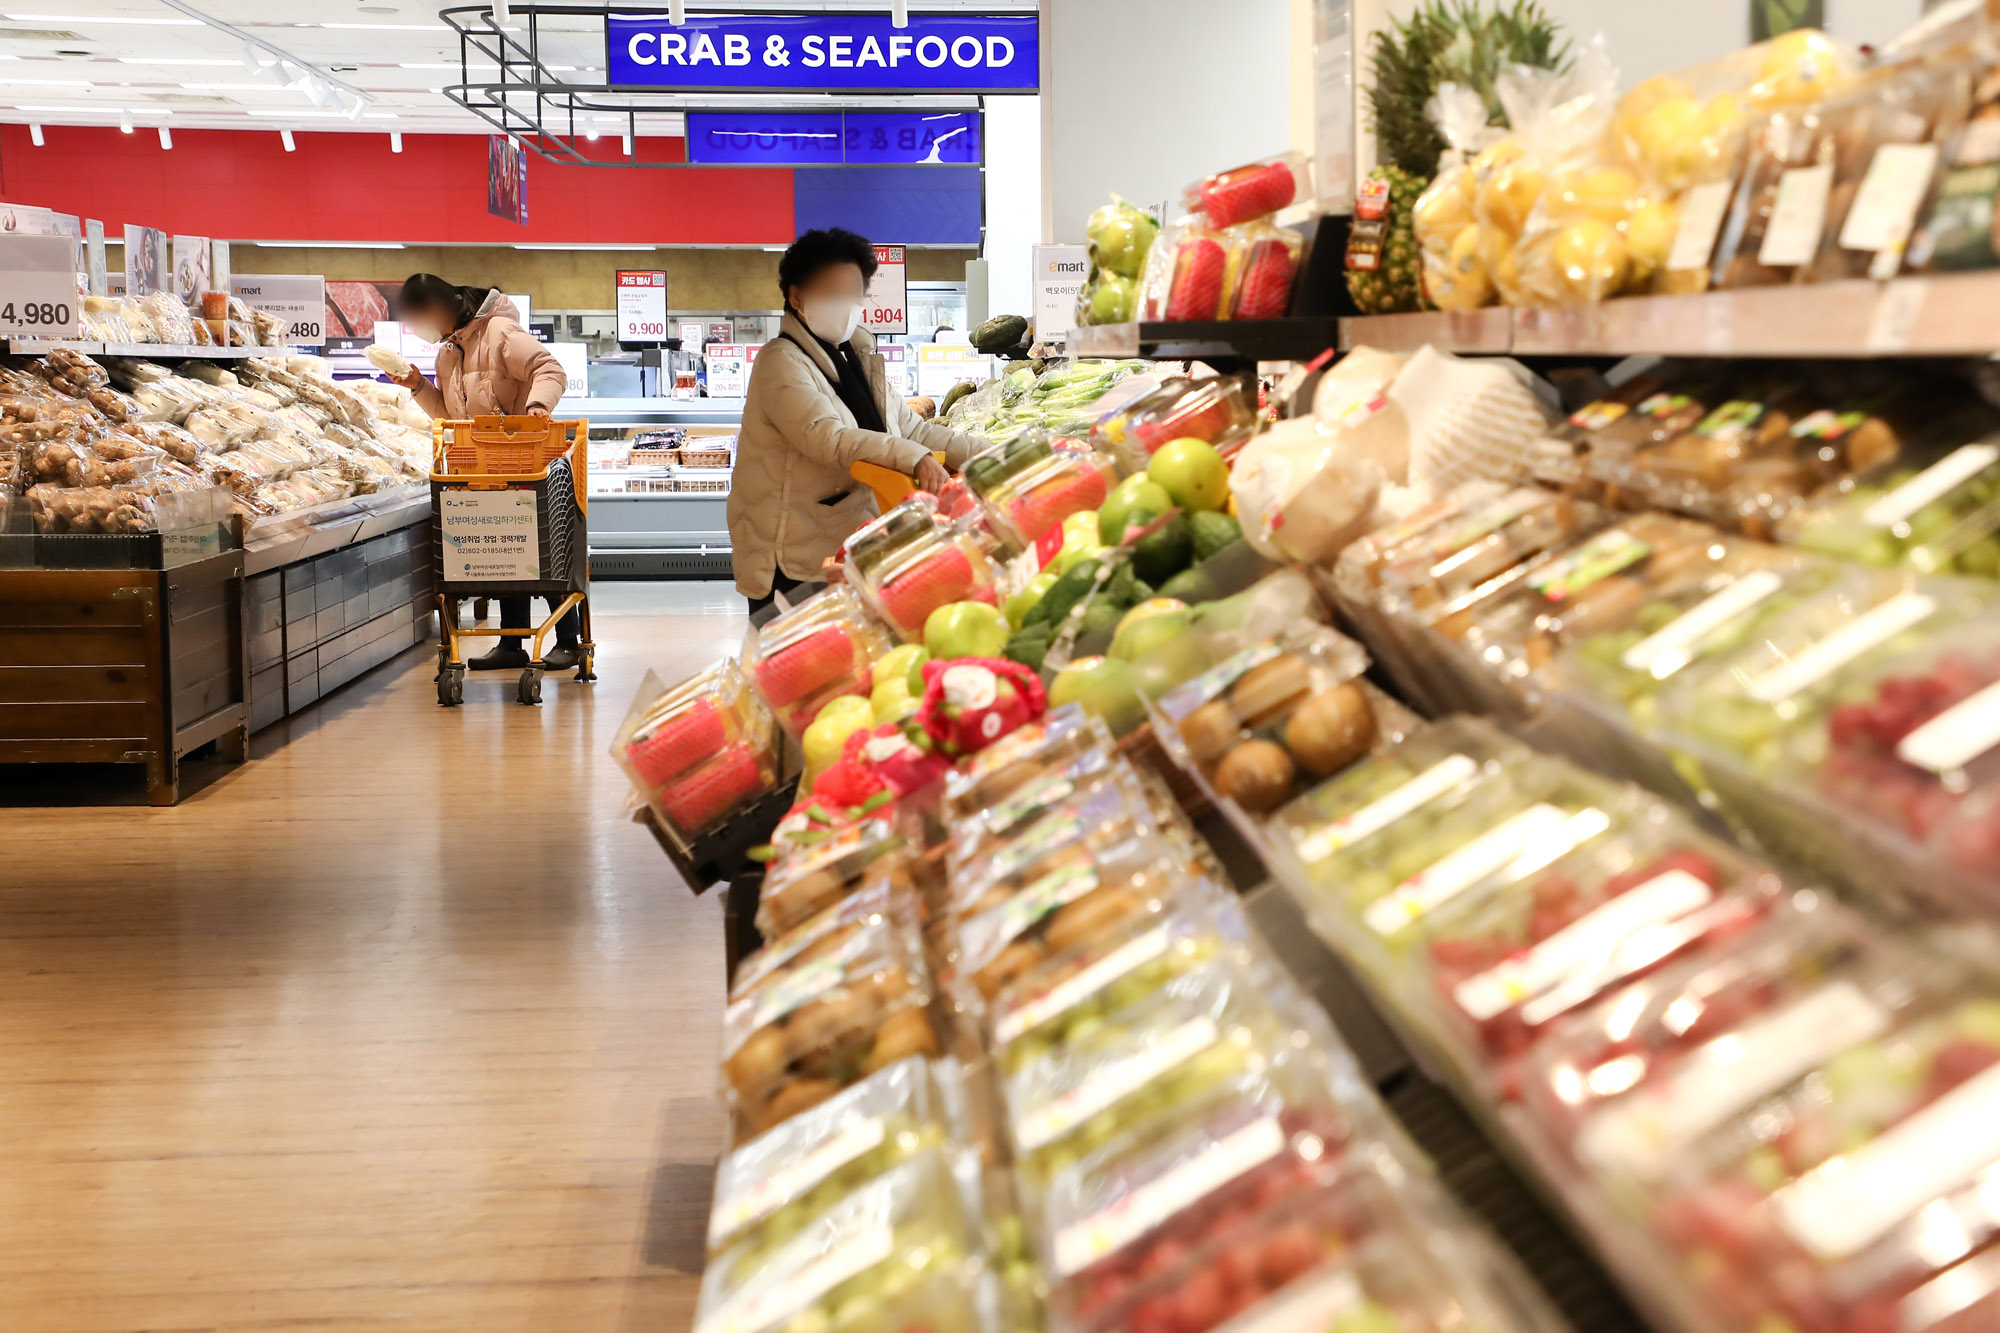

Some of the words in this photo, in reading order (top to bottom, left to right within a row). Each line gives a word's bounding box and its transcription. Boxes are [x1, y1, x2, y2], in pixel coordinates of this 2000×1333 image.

[628, 32, 751, 66] CRAB
[763, 35, 791, 67] &
[801, 34, 1015, 68] SEAFOOD
[1048, 261, 1085, 273] emart
[621, 277, 635, 285] 카드
[1, 302, 70, 327] 4,980
[862, 308, 903, 325] 1,904
[629, 322, 664, 336] 9,900
[565, 379, 584, 390] 80
[446, 515, 533, 525] 남부여성새로일하기센터
